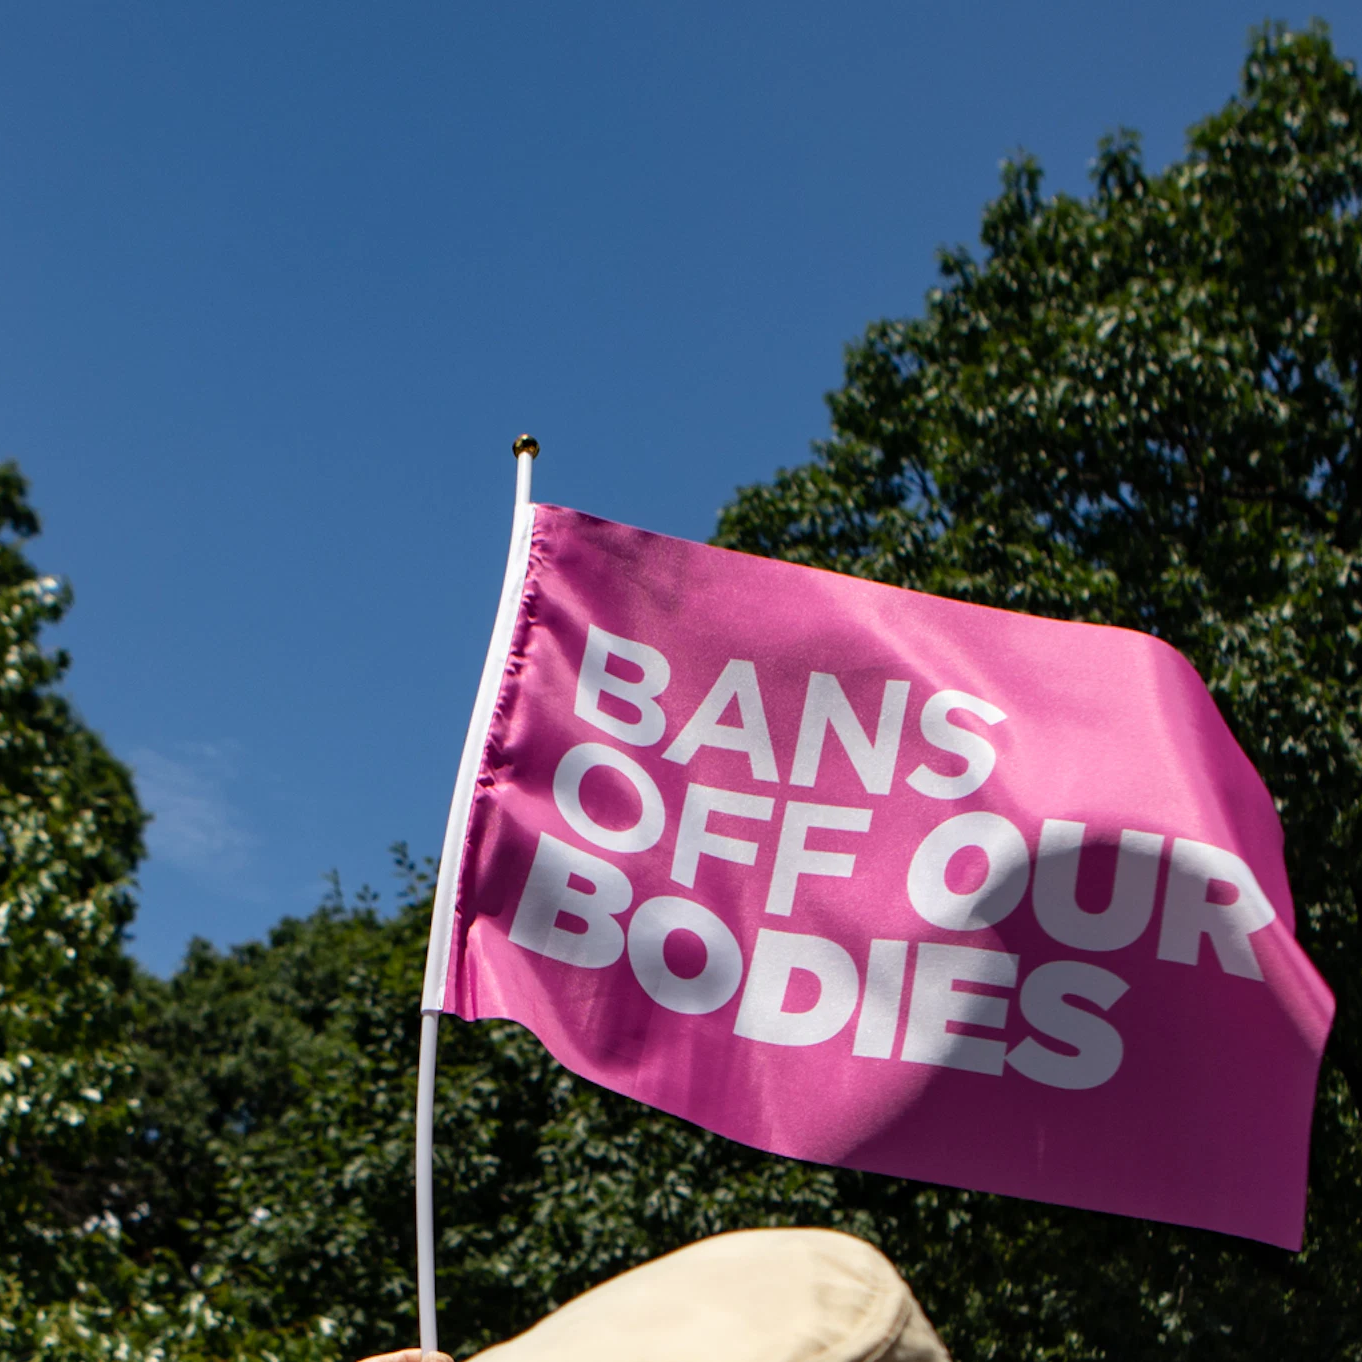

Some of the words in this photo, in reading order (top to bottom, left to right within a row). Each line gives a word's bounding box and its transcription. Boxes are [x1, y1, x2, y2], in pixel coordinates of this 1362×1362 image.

[574, 623, 1007, 800] BANS
[508, 833, 1130, 1090] BODIES
[553, 742, 873, 917] OFF
[907, 811, 1277, 982] OUR
